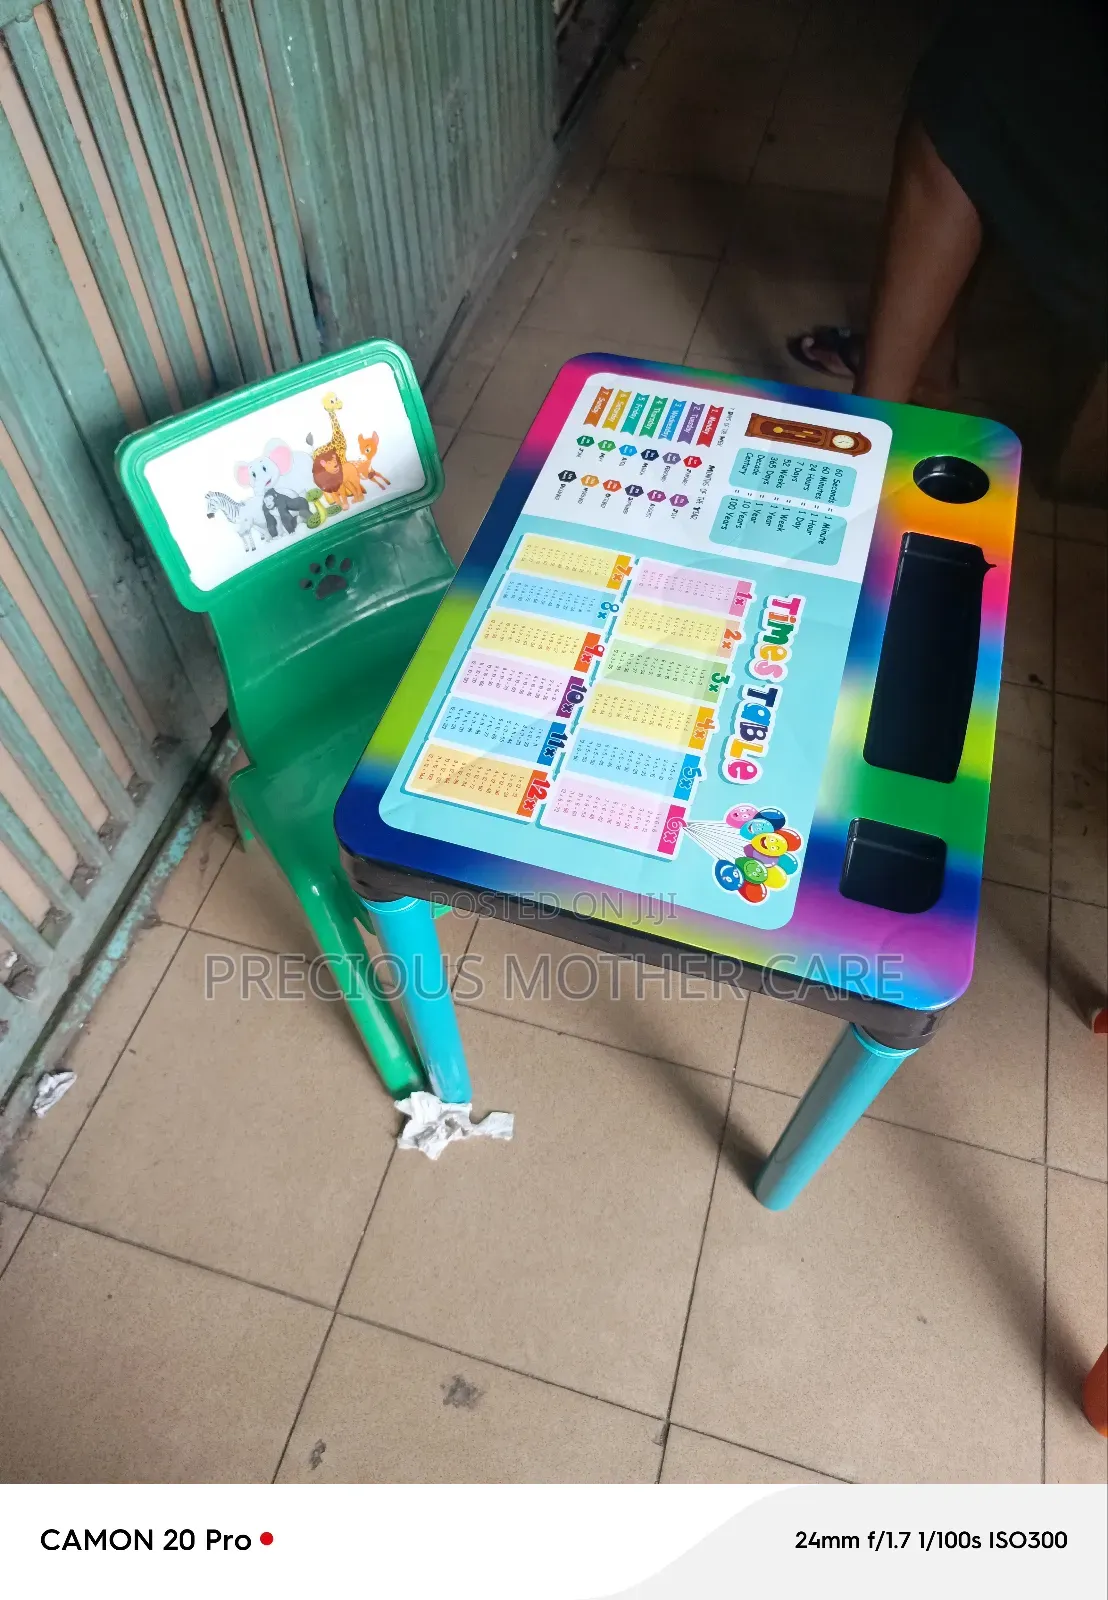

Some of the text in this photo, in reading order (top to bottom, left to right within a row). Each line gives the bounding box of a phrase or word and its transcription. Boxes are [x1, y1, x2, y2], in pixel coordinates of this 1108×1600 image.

[591, 397, 605, 413] Sunday
[608, 401, 624, 422] Saturday
[628, 403, 643, 419] Friday
[644, 407, 661, 429] Thursday
[660, 410, 679, 437] Wednesday
[683, 414, 698, 433] Tuesday
[702, 416, 716, 434] Monday
[738, 452, 754, 475] Century
[752, 454, 765, 475] Decade
[768, 456, 778, 468] 365
[782, 459, 792, 467] 52
[808, 463, 818, 471] 24
[821, 466, 830, 474] 60
[761, 470, 774, 484] Days
[775, 469, 788, 488] Weeks
[791, 467, 803, 482] Days
[834, 468, 843, 477] 60
[802, 473, 815, 490] Hours
[814, 475, 827, 499] Minutes
[828, 478, 840, 503] Seconds
[727, 497, 738, 510] 100
[742, 500, 751, 509] 10
[720, 512, 734, 530] Years
[735, 511, 748, 528] Years
[750, 509, 761, 523] Year
[765, 511, 776, 526] Year
[776, 514, 788, 531] Week
[791, 516, 804, 529] Day
[806, 519, 817, 535] Hour
[818, 522, 830, 544] Minute
